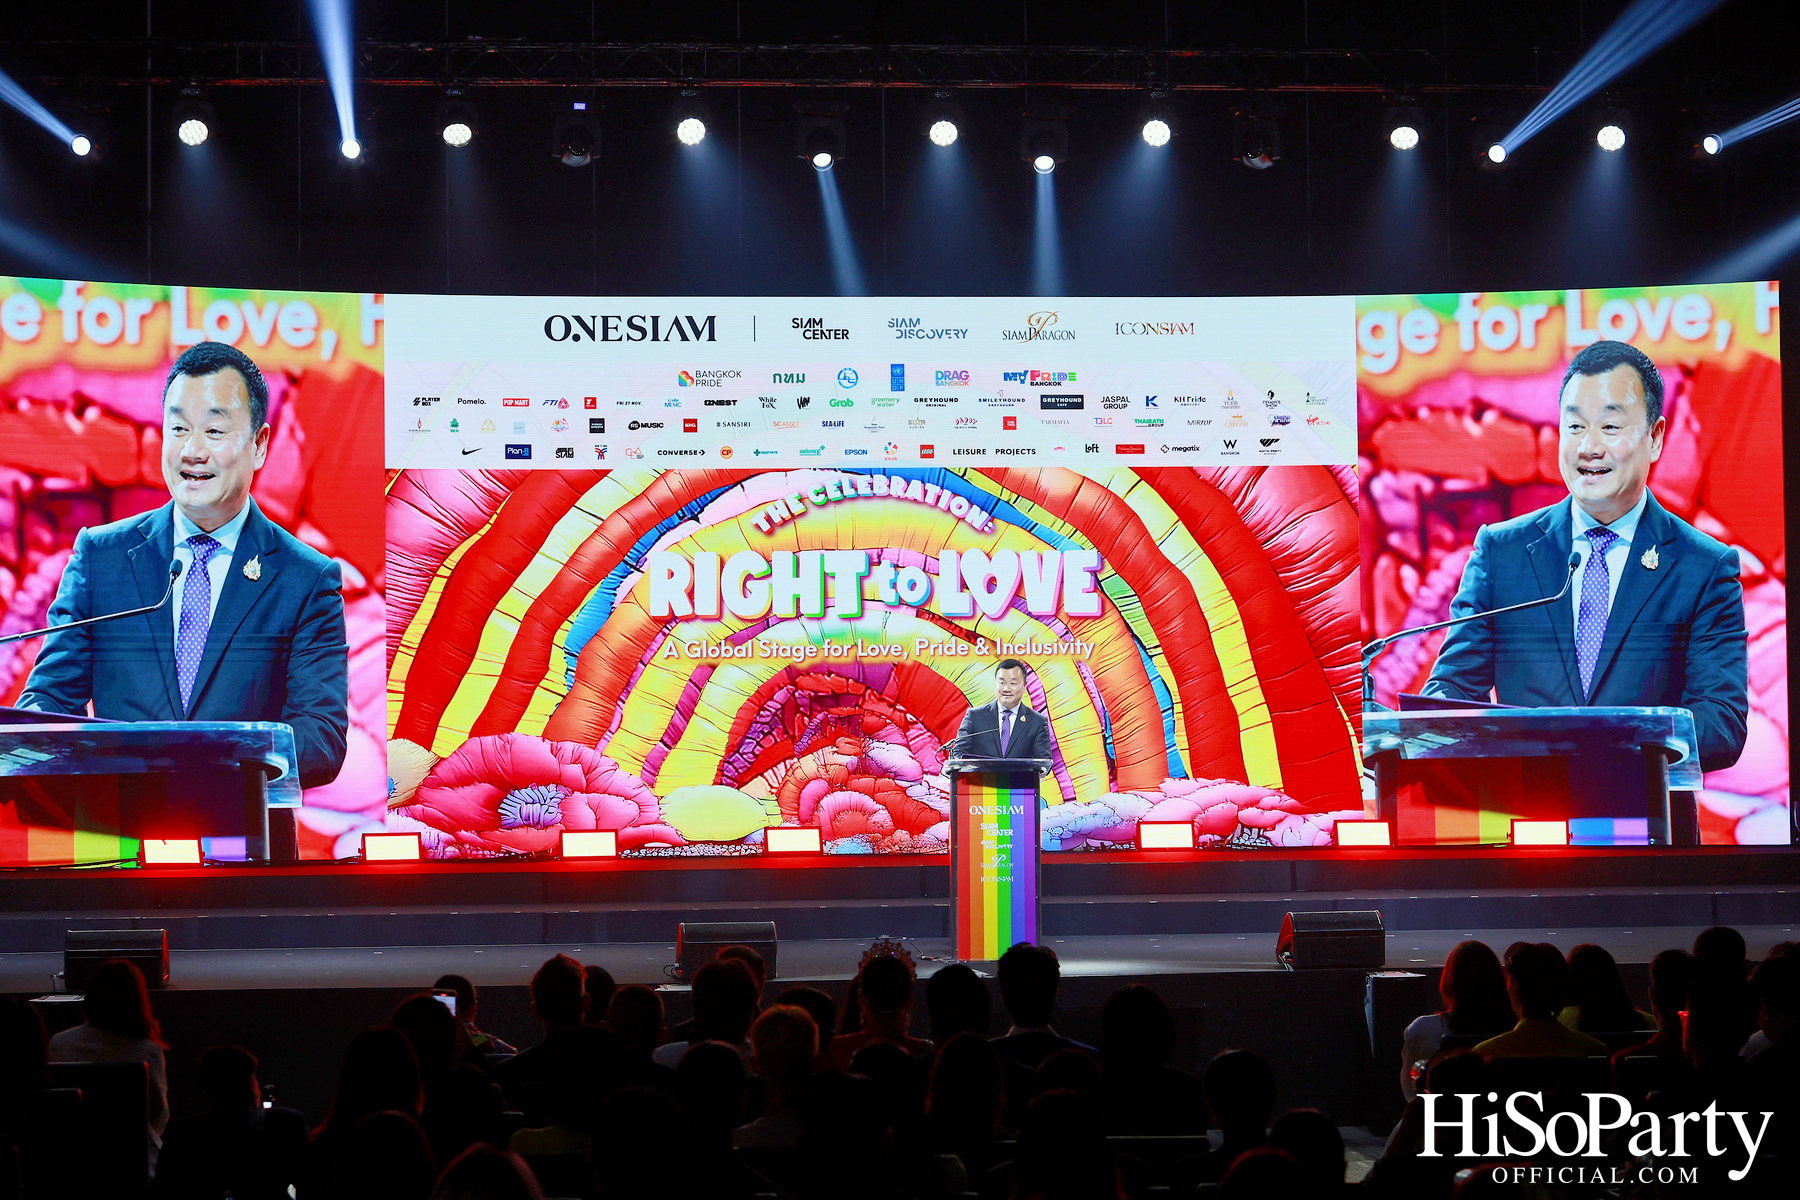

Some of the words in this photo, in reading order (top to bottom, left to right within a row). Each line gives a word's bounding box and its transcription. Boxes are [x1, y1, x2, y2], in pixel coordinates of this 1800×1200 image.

[57, 282, 153, 344] for
[170, 287, 338, 361] Love,
[792, 318, 823, 329] SIAM
[888, 318, 920, 328] SIAM
[1455, 293, 1549, 352] for
[1565, 290, 1732, 352] Love,
[544, 315, 717, 342] ONESIAM
[895, 329, 968, 339] DISCOVERY
[1115, 322, 1194, 335] ICONSIAM
[803, 329, 849, 340] CENTER
[772, 373, 806, 384] กทม
[935, 370, 969, 381] DRAG
[1003, 370, 1029, 384] MY
[1030, 370, 1077, 382] PRIDE
[695, 379, 723, 387] PRIDE
[829, 398, 854, 407] Grab
[1172, 445, 1200, 453] megatix
[1223, 439, 1237, 449] W
[995, 448, 1036, 456] PROJECTS
[751, 490, 804, 534] THE
[808, 474, 996, 534] CELEBRATION:
[650, 549, 870, 619] RIGHT
[878, 558, 931, 606] to
[938, 548, 1102, 618] LOVE
[663, 641, 679, 659] A
[684, 638, 754, 659] Global
[758, 639, 818, 663] Stage
[822, 638, 852, 658] for
[857, 639, 910, 662] Love,
[915, 638, 971, 657] Pride
[975, 639, 991, 657] &
[996, 637, 1096, 659] Inclusivity
[969, 805, 1025, 815] ONESIAM
